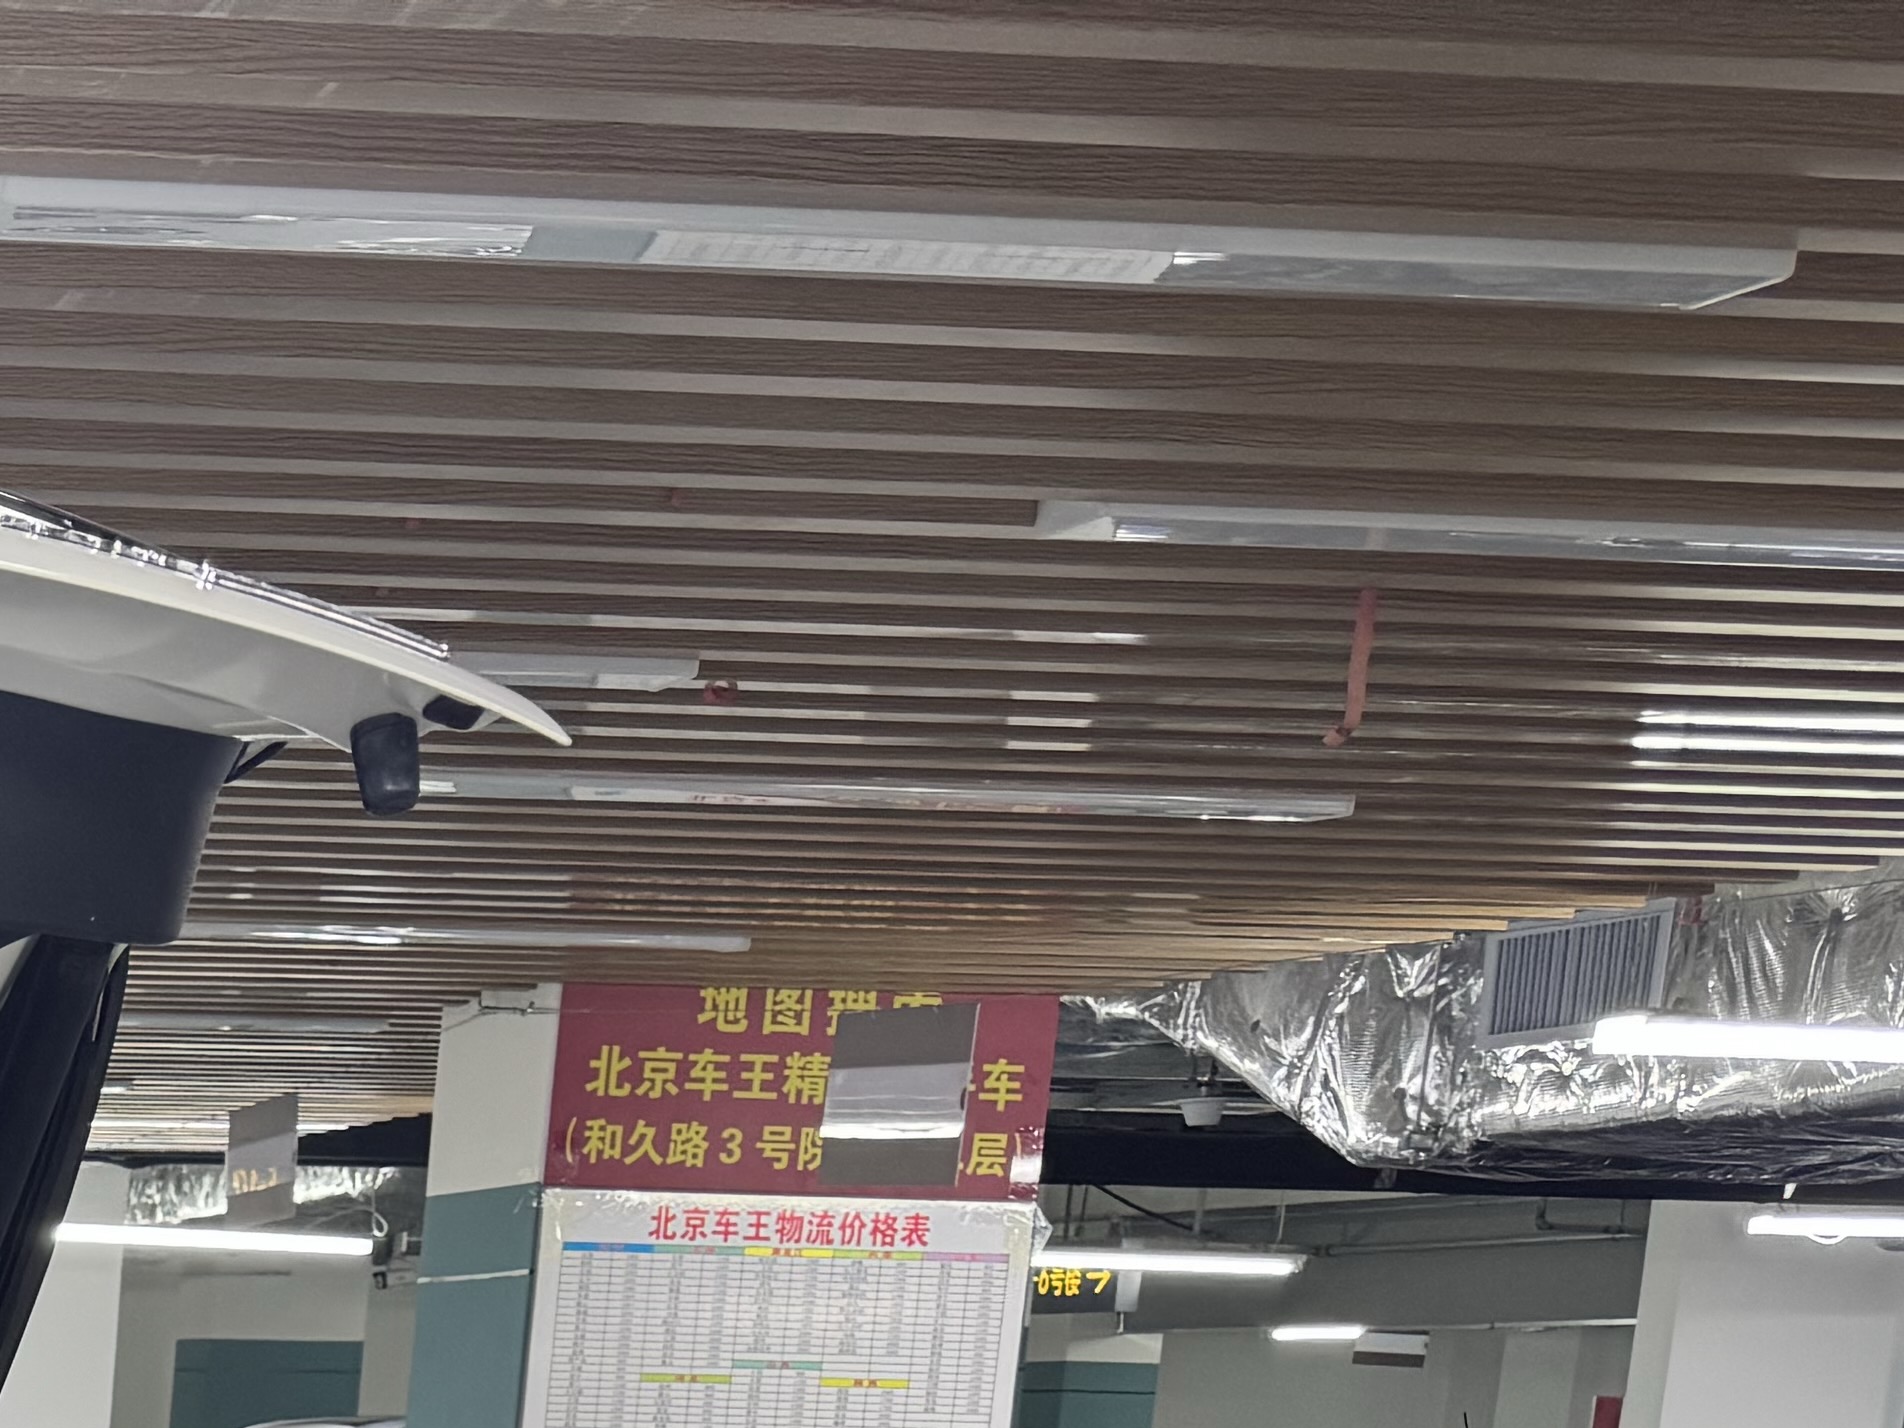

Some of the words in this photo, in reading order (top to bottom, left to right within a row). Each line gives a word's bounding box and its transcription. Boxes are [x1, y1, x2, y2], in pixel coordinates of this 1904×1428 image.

[585, 1045, 1025, 1111] 北京车王精车
[648, 1205, 932, 1248] 北京车王物流价格表
